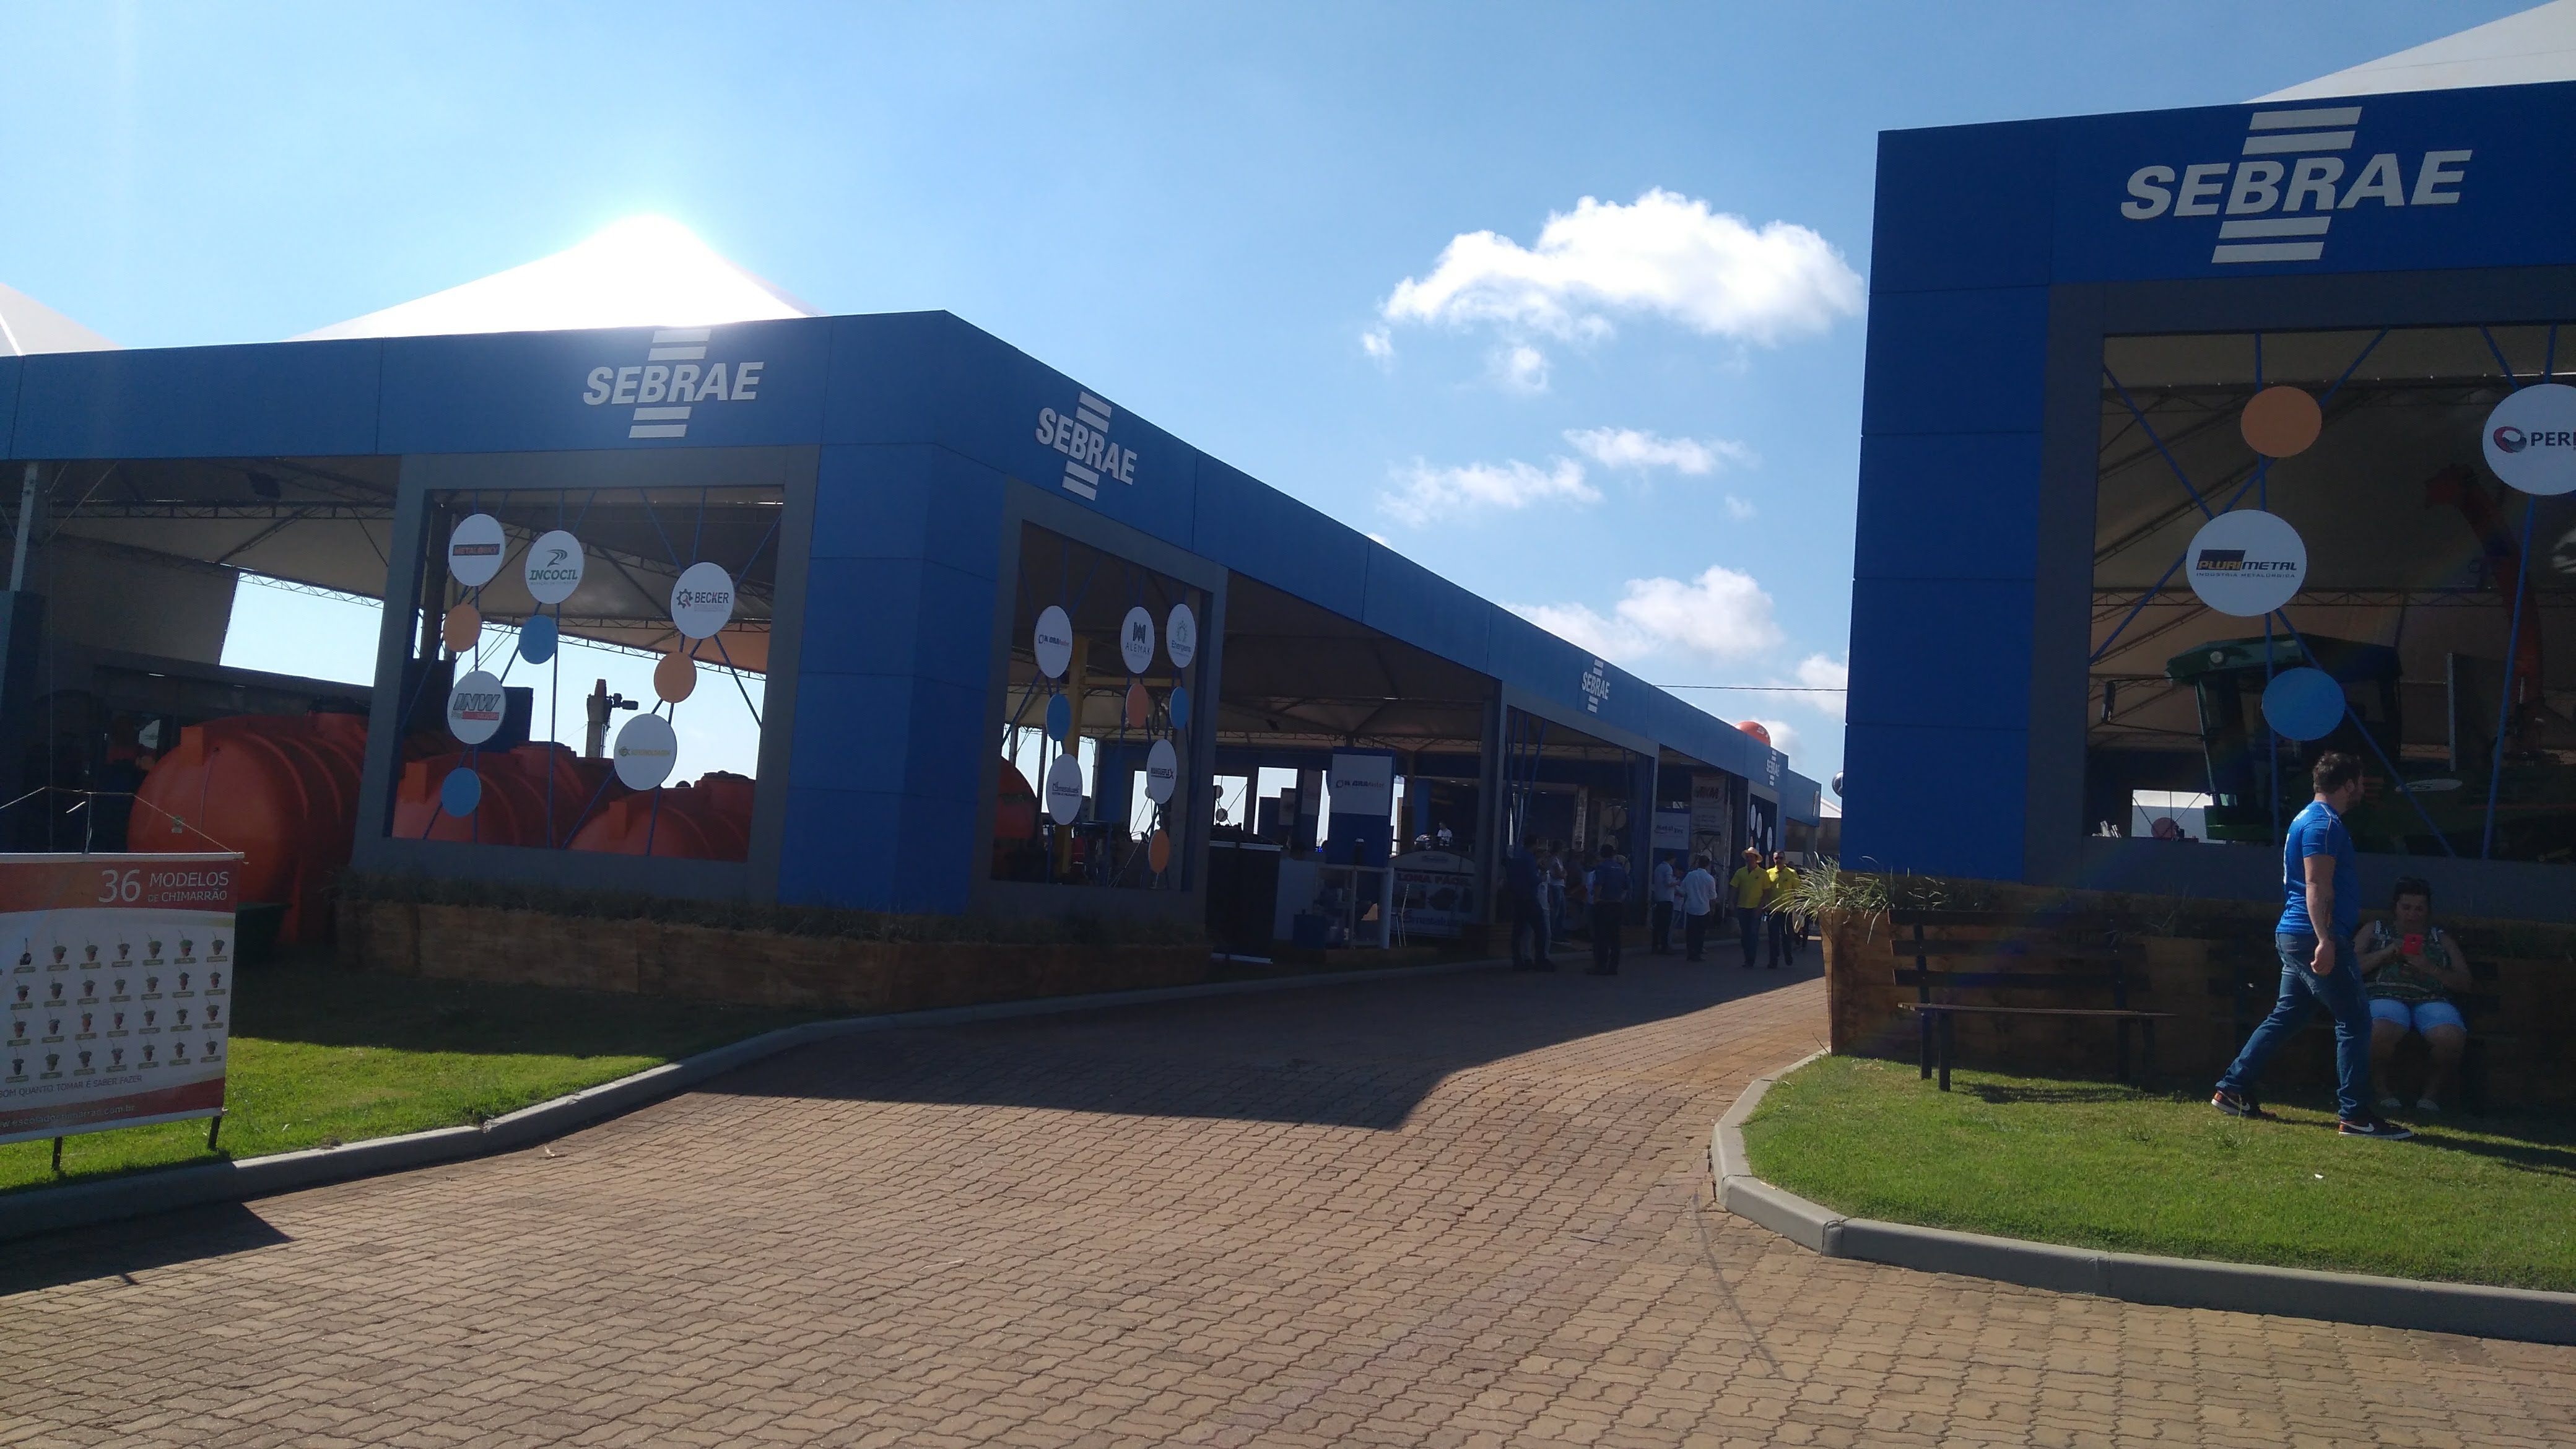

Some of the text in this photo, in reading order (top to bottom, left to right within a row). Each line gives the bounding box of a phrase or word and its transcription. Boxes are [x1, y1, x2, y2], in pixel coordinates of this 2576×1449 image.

[2120, 149, 2473, 219] SEBRAE
[583, 362, 764, 406] SEBRAE
[1035, 407, 1138, 485] SEBRAE
[2530, 432, 2576, 446] PER
[529, 569, 578, 581] INCOCIL
[2196, 561, 2297, 571] PLURIMETAL
[694, 592, 729, 604] BECKER
[1125, 642, 1151, 655] ALEMAK
[1582, 671, 1611, 701] SEBRAE
[453, 692, 501, 711] INW
[1766, 758, 1780, 777] SEBRAE
[98, 869, 141, 903] 36
[149, 871, 230, 887] MODELOS
[148, 887, 227, 902] DE CHIMARRÃO
[19, 1084, 53, 1097] QUANTO
[57, 1081, 84, 1092] TOMAR
[86, 1079, 91, 1088] É
[94, 1077, 117, 1087] SABER
[120, 1075, 142, 1085] FAZER
